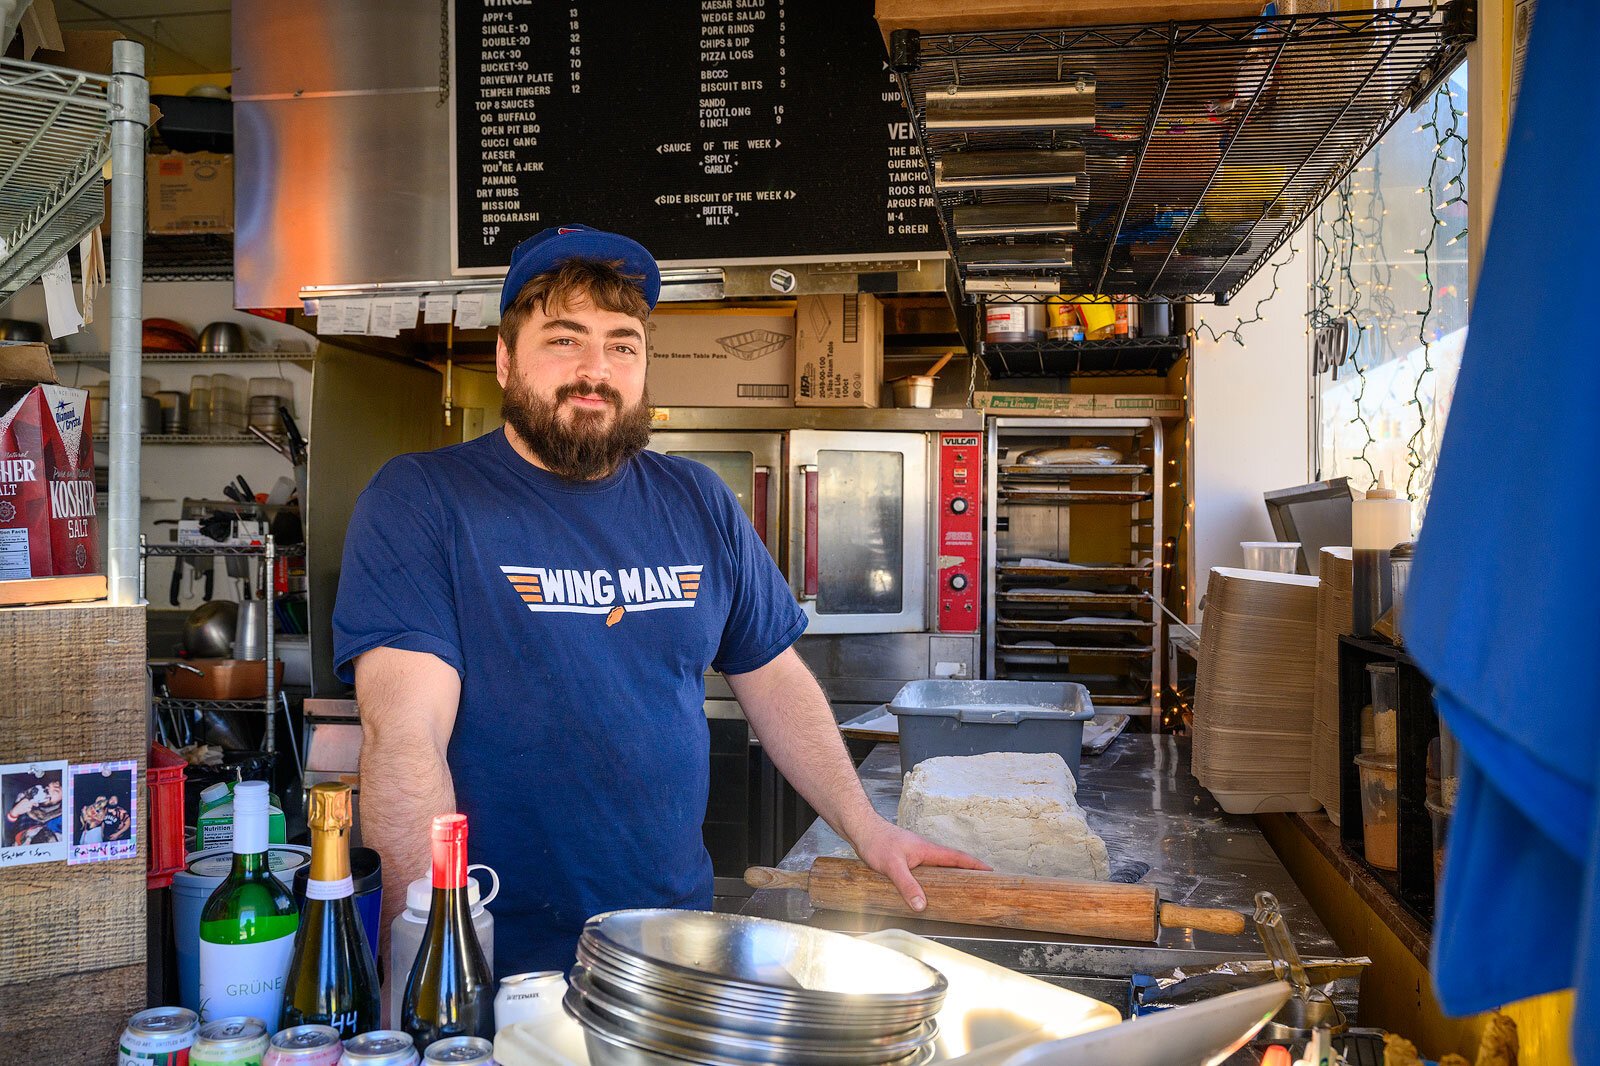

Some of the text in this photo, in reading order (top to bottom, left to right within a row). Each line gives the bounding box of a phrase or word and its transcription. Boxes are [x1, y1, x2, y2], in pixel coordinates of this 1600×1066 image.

[702, 1, 732, 10] KAESAR
[736, 0, 764, 8] SALAD
[570, 9, 577, 17] 13
[702, 10, 784, 22] WEDGE SALAD 9
[570, 21, 579, 30] 18
[702, 23, 785, 35] PORK RINDS 5
[570, 34, 580, 42] 32
[700, 36, 785, 48] CHIPS & DIP 5
[570, 47, 580, 55] 45
[701, 48, 785, 61] PIZZA LOGS 8
[570, 59, 581, 68] 70
[780, 67, 785, 75] 3
[481, 72, 580, 85] DRIVEWAY PLATE 16
[701, 79, 785, 92] BISCUIT BITS 5
[481, 85, 580, 97] TEMPEH FINGERS 12
[882, 92, 901, 101] UND
[475, 100, 534, 110] TOP 8 SAUCES
[699, 98, 725, 107] SANDO
[481, 112, 536, 122] OG BUFFALO
[700, 106, 784, 118] FOOTLONG 16
[700, 116, 781, 128] 6 INCH 9
[482, 125, 540, 135] OPEN PIT BBQ
[888, 122, 917, 140] VEN
[481, 137, 536, 147] GUCCI GANG
[663, 139, 771, 152] SAUCE OF THE WEEK
[482, 151, 515, 160] KAESER
[888, 146, 921, 156] THE BR
[705, 154, 730, 163] SPICY
[888, 159, 924, 168] GUERNS
[516, 163, 522, 171] A
[523, 162, 543, 171] JERK
[704, 165, 732, 174] GARLIC
[482, 176, 516, 185] PANANG
[889, 172, 928, 182] TAMCHO
[477, 188, 519, 198] DRY RUBS
[889, 185, 931, 195] ROOS RO
[660, 195, 681, 205] SIDE
[684, 193, 720, 203] BISCUIT
[722, 193, 733, 202] OF
[735, 192, 752, 201] THE
[756, 191, 781, 200] WEEK
[887, 198, 934, 208] ARGUS FAR
[482, 201, 520, 210] MISSION
[703, 206, 733, 215] BUTTER
[483, 213, 539, 222] BROGARASHI
[706, 216, 729, 225] MILK
[483, 226, 500, 235] S&P
[888, 225, 928, 234] B GREEN
[484, 236, 495, 245] LP
[801, 376, 810, 397] HFA
[56, 407, 75, 423] Diamond
[66, 416, 81, 430] Crystal
[0, 459, 36, 482] HER
[50, 480, 96, 519] KOSHER
[68, 519, 89, 538] SALT
[539, 566, 682, 605] WING MAN
[226, 976, 282, 997] GRÜNE
